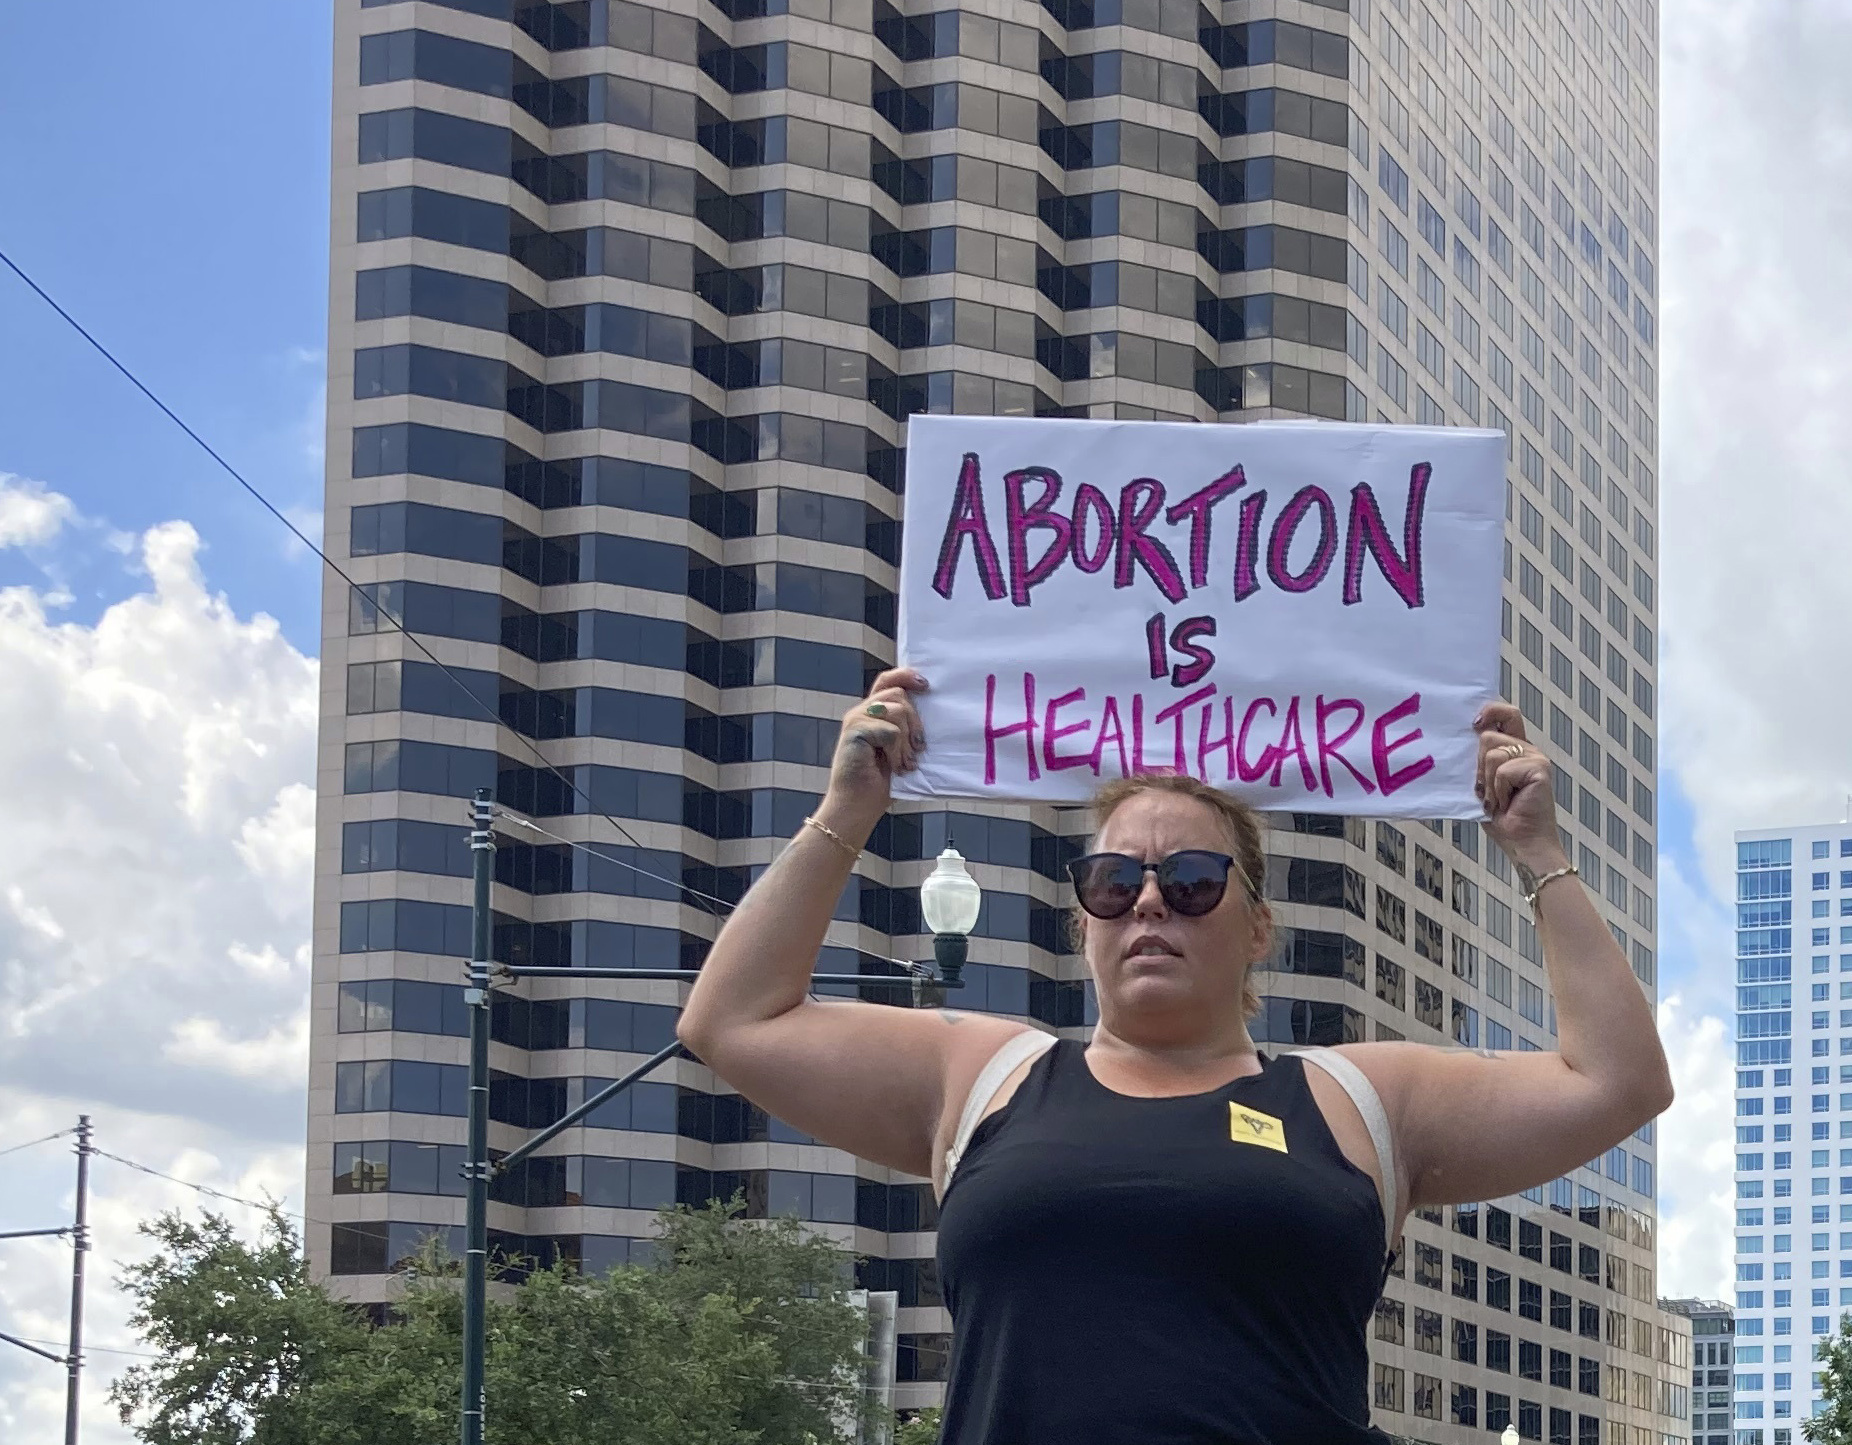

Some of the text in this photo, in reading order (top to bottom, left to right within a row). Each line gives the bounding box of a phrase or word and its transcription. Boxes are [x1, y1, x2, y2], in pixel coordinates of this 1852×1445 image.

[932, 452, 1432, 608] ABORTION
[1147, 612, 1217, 687] IS
[984, 672, 1436, 798] HEALTHCARE
